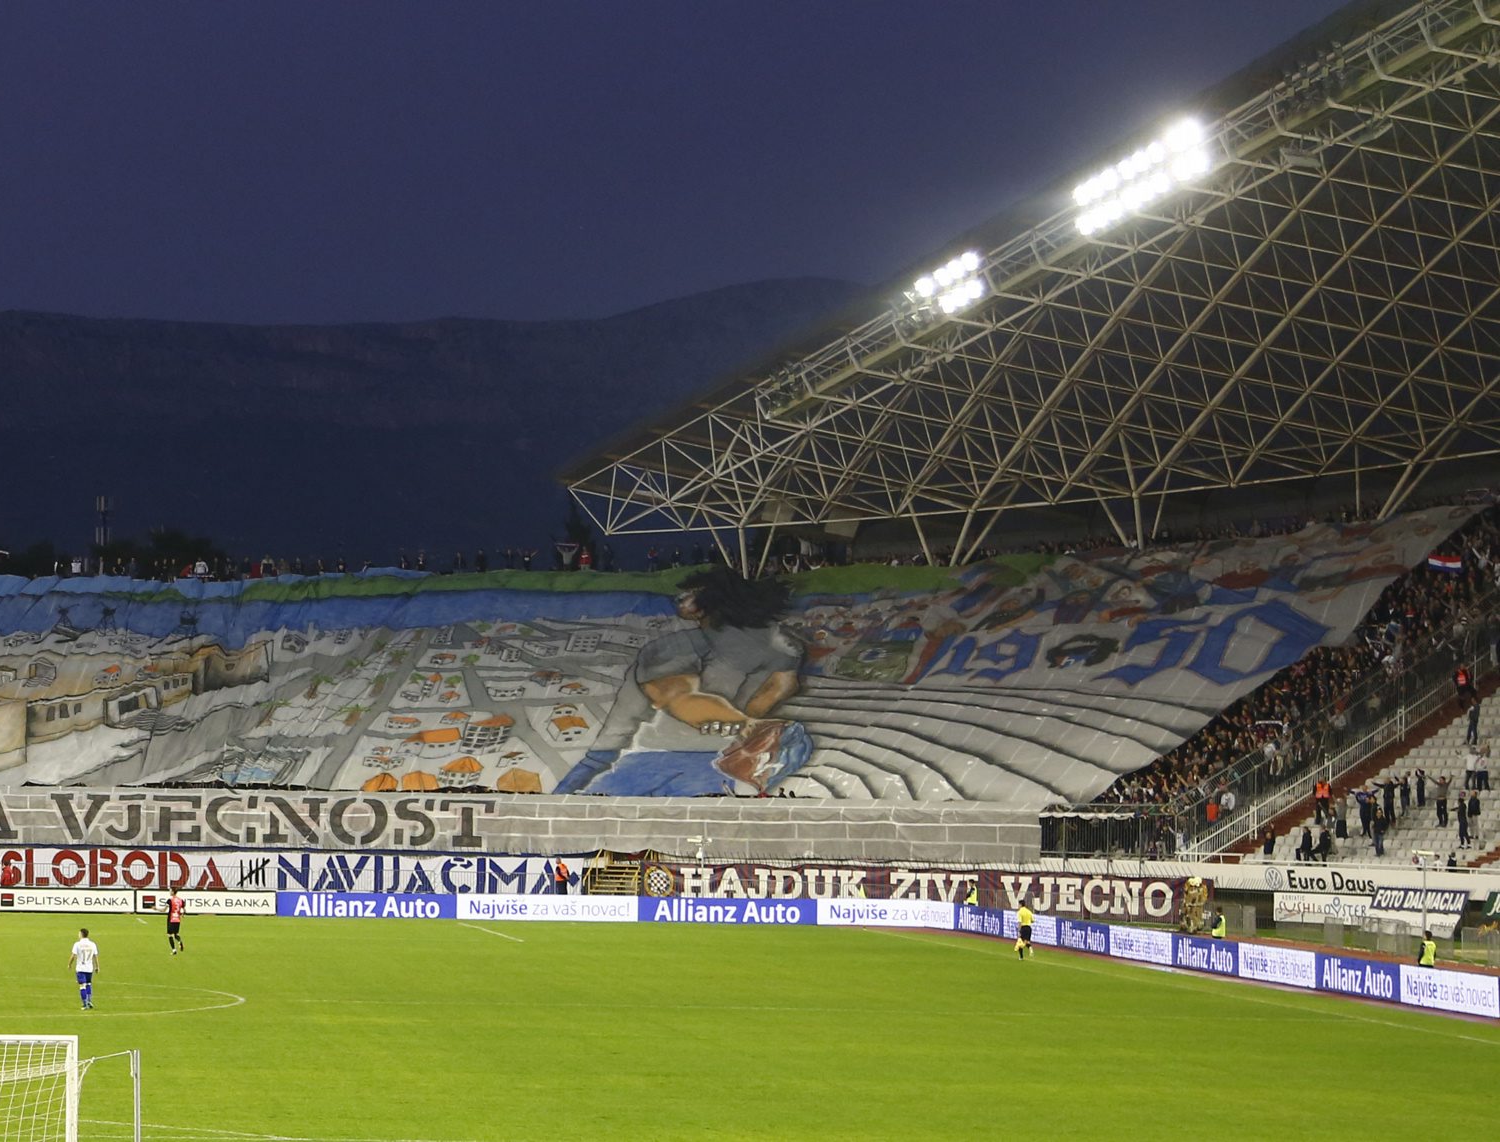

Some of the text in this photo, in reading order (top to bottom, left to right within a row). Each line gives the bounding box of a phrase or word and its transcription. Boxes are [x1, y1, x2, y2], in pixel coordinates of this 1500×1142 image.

[1090, 600, 1332, 687] 50
[0, 848, 228, 891] SLOBODA
[277, 853, 557, 895] NAVIJAČIMA
[1287, 869, 1376, 893] Euro Daus
[17, 896, 129, 906] SPLITSKA BANKA
[159, 897, 270, 908] SITSKA BANKA
[680, 866, 867, 900] HAJDUK
[1000, 875, 1174, 918] VJEČNO
[1373, 889, 1466, 911] FOTO DALMACIJA
[294, 895, 440, 919] Allianz Auto
[469, 899, 630, 918] Najviše za vaš novac!
[654, 899, 801, 923] Allianz Auto
[830, 904, 888, 923] Najviše
[892, 908, 908, 921] za
[958, 906, 983, 932] Allianz
[983, 911, 1000, 935] Auto
[1060, 919, 1086, 949] Allianz
[1087, 925, 1105, 953] Auto
[1176, 938, 1233, 973] Allianz Auto
[1322, 958, 1393, 999] Allianz Auto
[1406, 974, 1495, 1009] Najviše za vaš novac!
